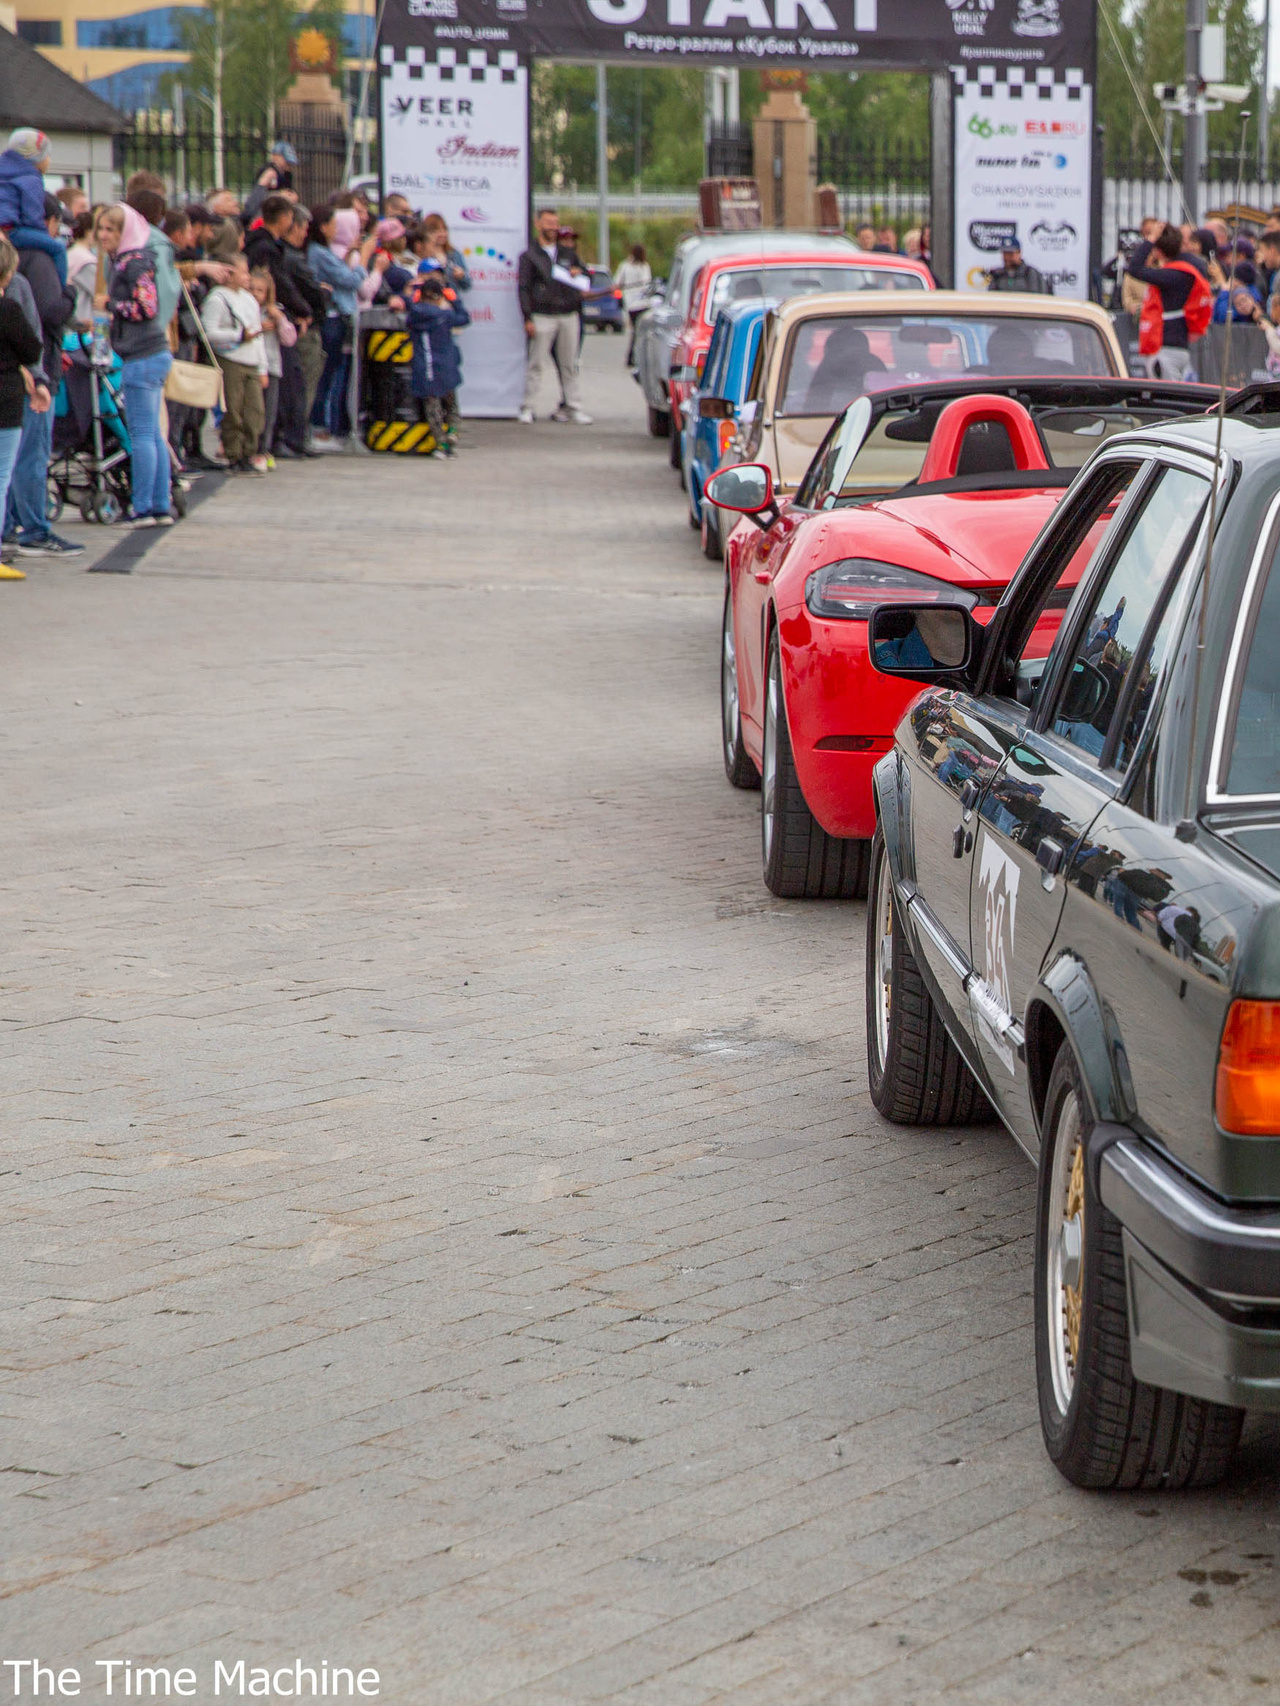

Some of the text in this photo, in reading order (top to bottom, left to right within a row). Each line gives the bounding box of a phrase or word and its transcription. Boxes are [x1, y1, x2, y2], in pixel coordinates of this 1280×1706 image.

[624, 31, 860, 56] Ретро-ралли «Кубок Урала»
[396, 97, 474, 116] VEER
[436, 134, 521, 160] Indian
